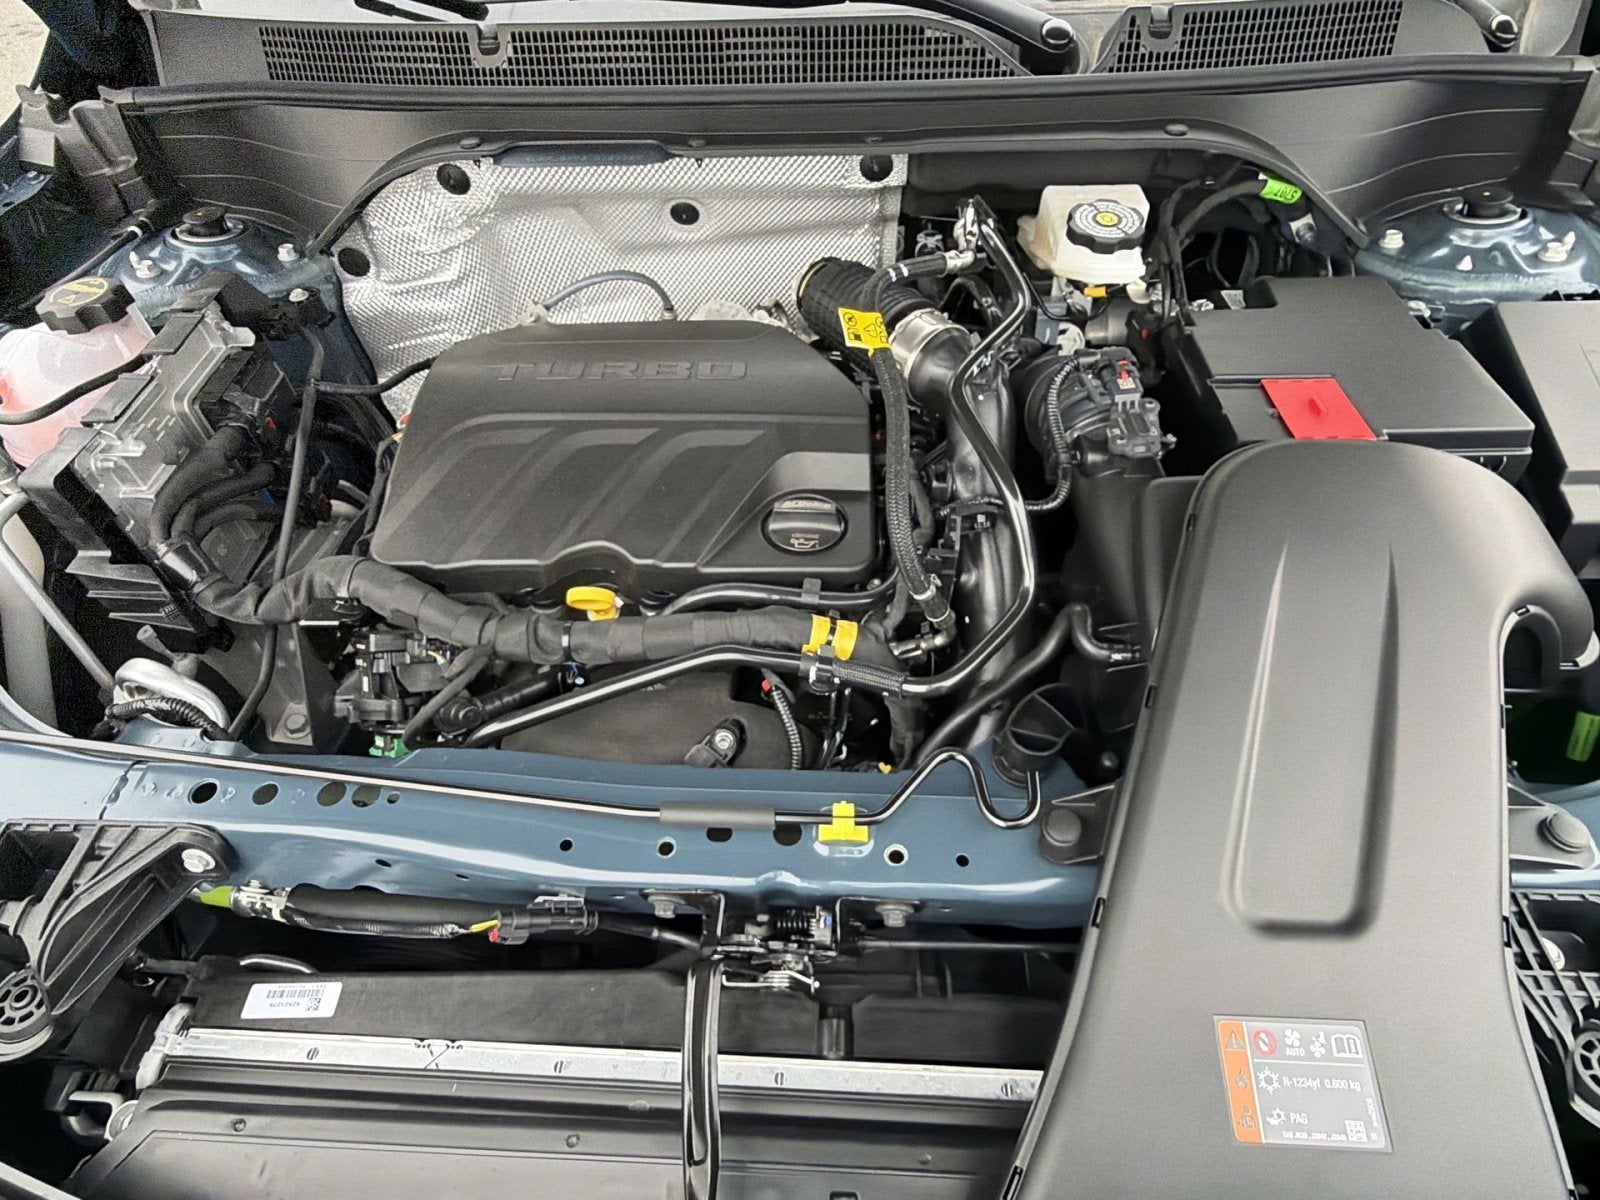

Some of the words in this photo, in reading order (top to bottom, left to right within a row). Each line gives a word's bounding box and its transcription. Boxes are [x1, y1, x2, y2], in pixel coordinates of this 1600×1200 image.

[488, 362, 747, 382] TURBO
[1285, 1047, 1305, 1057] AUTO
[1283, 1076, 1321, 1089] R-1234yf
[1349, 1079, 1361, 1092] kg
[1290, 1112, 1308, 1125] PAG
